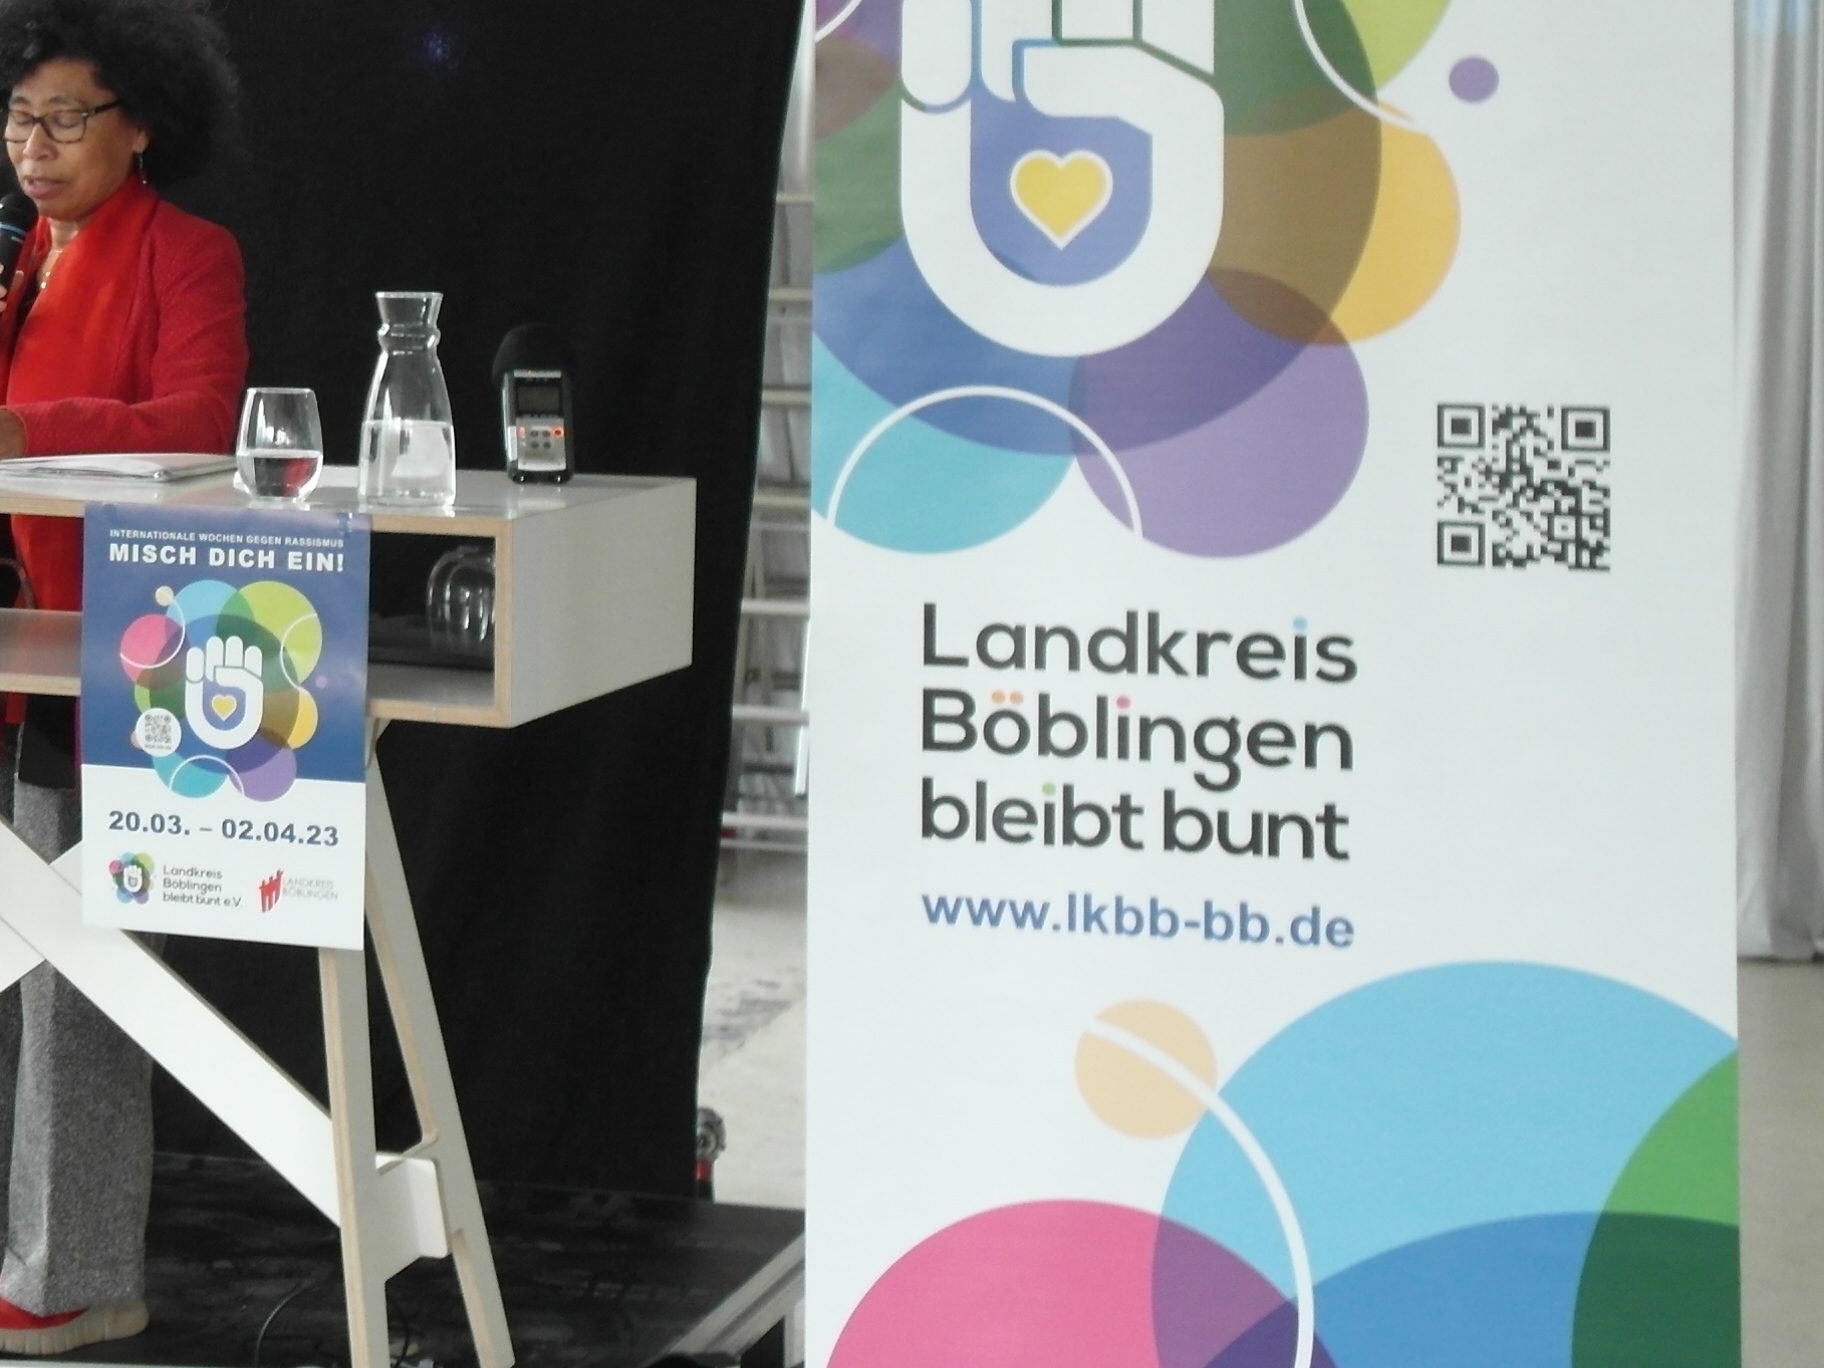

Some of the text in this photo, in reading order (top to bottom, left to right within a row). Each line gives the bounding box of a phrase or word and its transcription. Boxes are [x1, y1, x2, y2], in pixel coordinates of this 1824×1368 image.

[110, 529, 344, 549] INTERNATIONALE WOCHEN GEGEN RASSISMUS
[109, 543, 344, 573] MISCH DICH EIN!
[923, 602, 1358, 684] Landkreis
[922, 687, 1354, 793] Böblingen
[109, 810, 191, 836] 20.03.
[222, 819, 339, 847] 02.04.23
[921, 776, 1351, 862] bleibt bunt
[163, 864, 223, 880] Landkreis
[163, 877, 222, 895] Böblingen
[163, 890, 243, 908] bleibt bunt e.V.
[921, 890, 1356, 949] www.lkbb-bb.de
